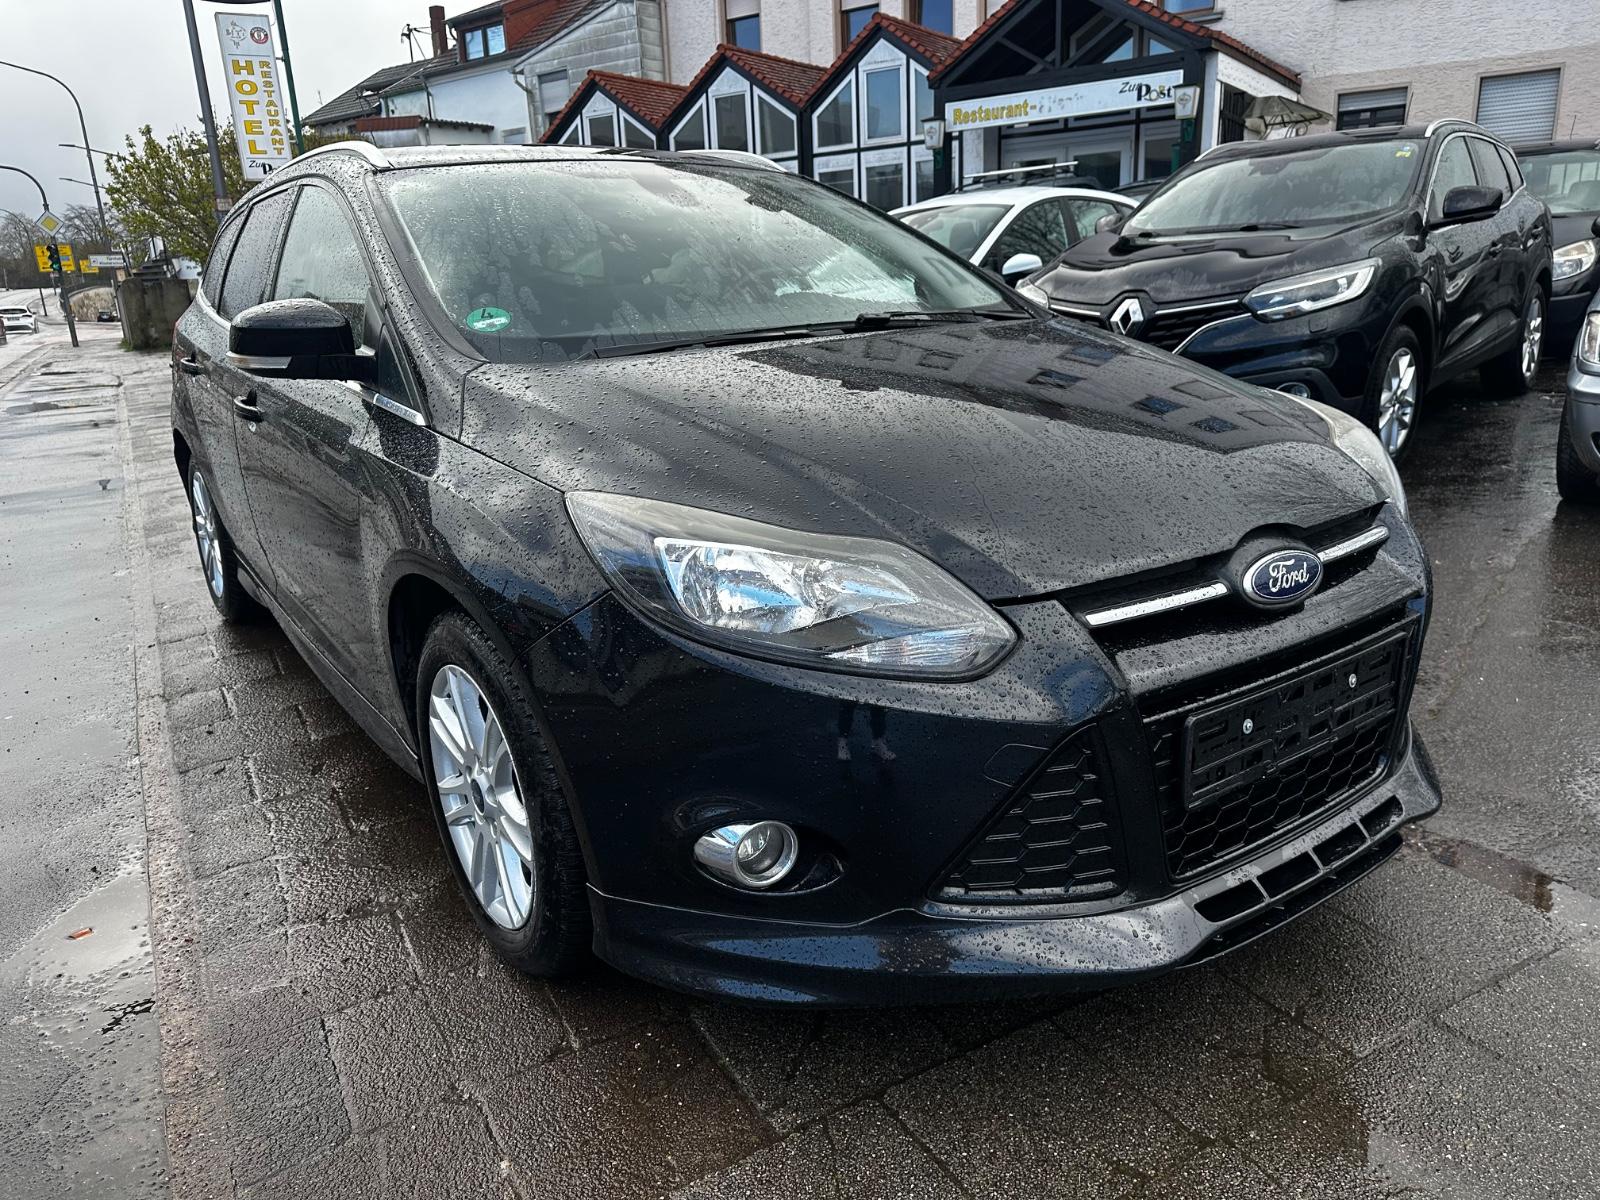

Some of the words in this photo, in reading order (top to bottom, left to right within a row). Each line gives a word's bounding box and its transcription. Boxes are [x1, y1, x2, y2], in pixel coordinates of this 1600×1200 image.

[1119, 81, 1141, 94] Zur
[1136, 83, 1173, 102] Post
[231, 59, 268, 155] HOTEL
[258, 60, 285, 155] RESTAURANT
[248, 160, 266, 168] Zur
[481, 308, 494, 319] 4
[1268, 558, 1310, 593] Ford
